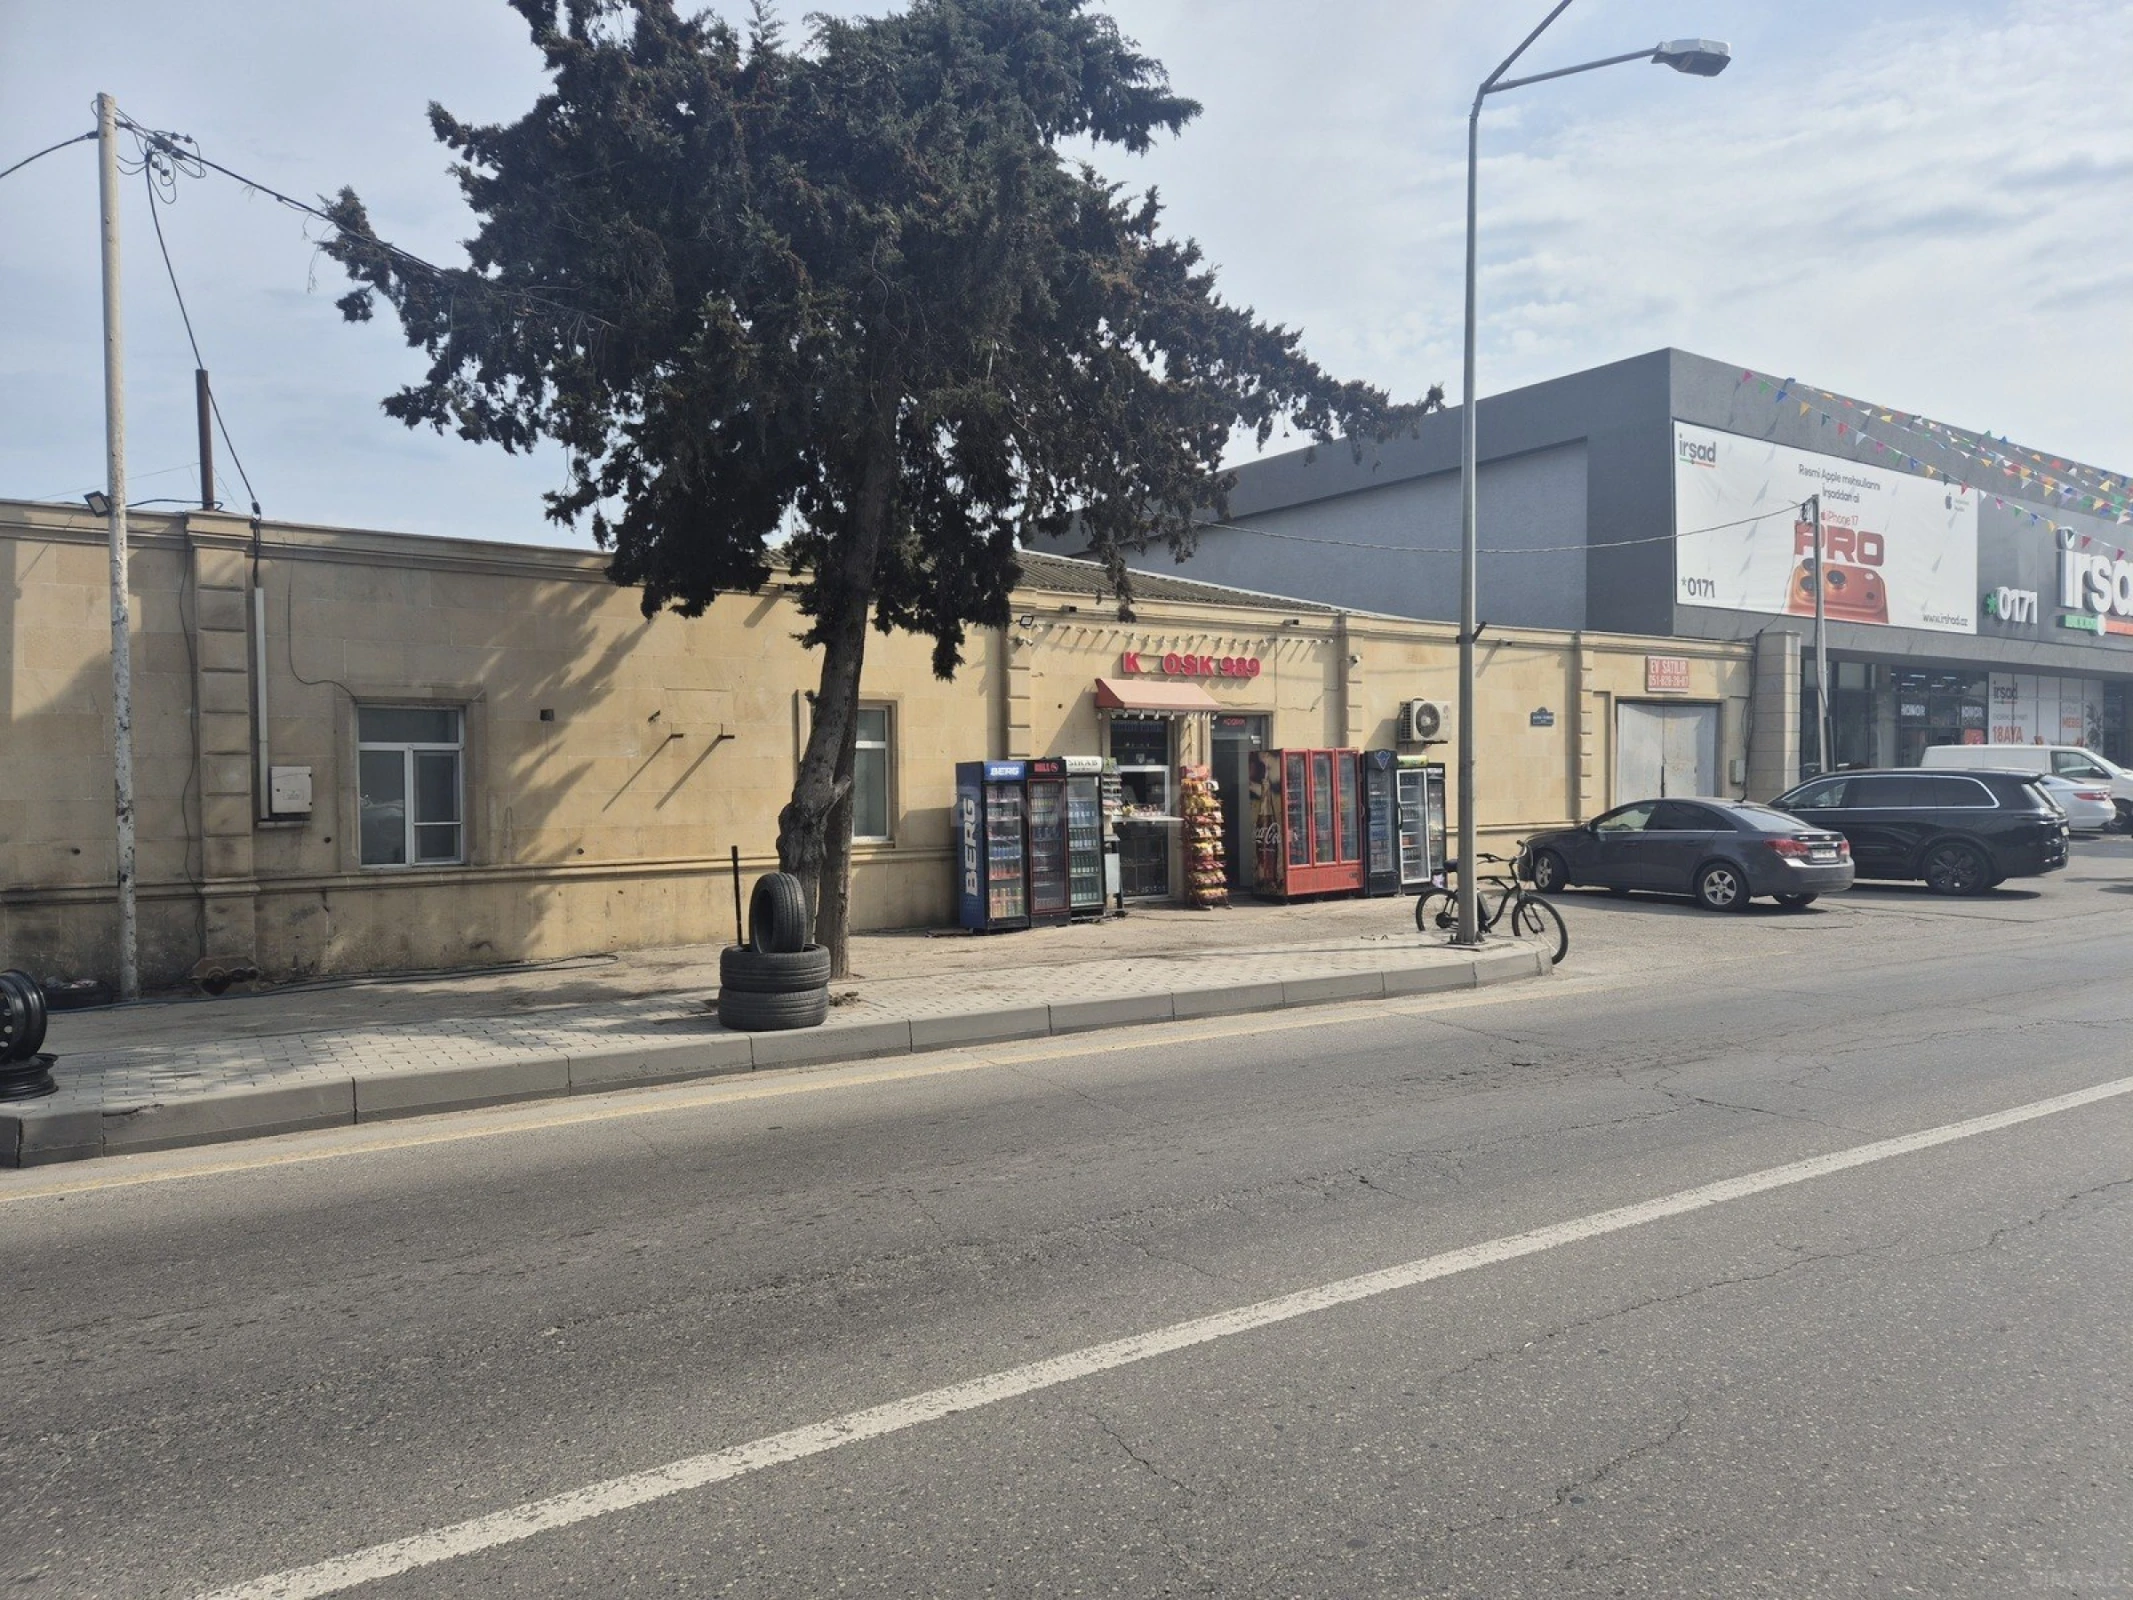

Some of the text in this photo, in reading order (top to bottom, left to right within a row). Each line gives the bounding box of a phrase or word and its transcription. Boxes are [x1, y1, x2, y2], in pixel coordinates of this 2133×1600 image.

[1794, 520, 1884, 567] PRO
[1220, 656, 1261, 678] 989
[990, 767, 1020, 776] BERG
[963, 798, 978, 897] BERG
